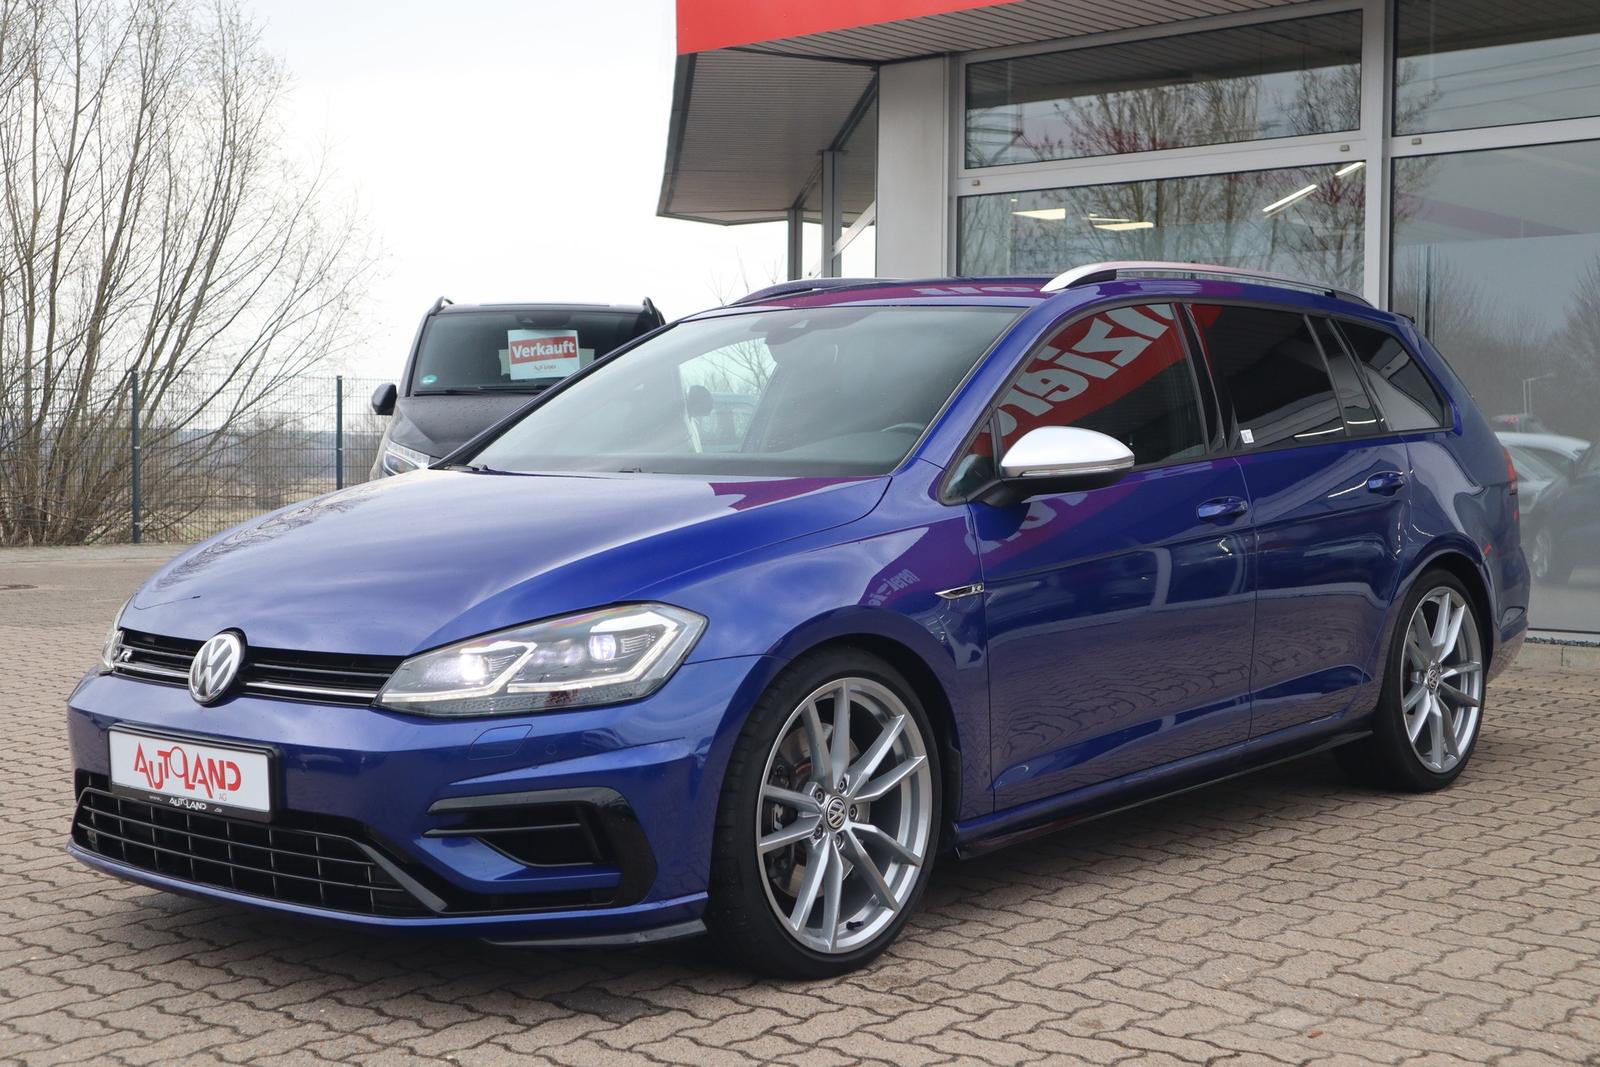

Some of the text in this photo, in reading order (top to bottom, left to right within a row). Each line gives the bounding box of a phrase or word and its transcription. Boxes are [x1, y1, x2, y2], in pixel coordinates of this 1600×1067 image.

[512, 340, 575, 358] Verkauft
[134, 742, 242, 799] AUTOLAND
[169, 797, 207, 811] AUTOLAND
